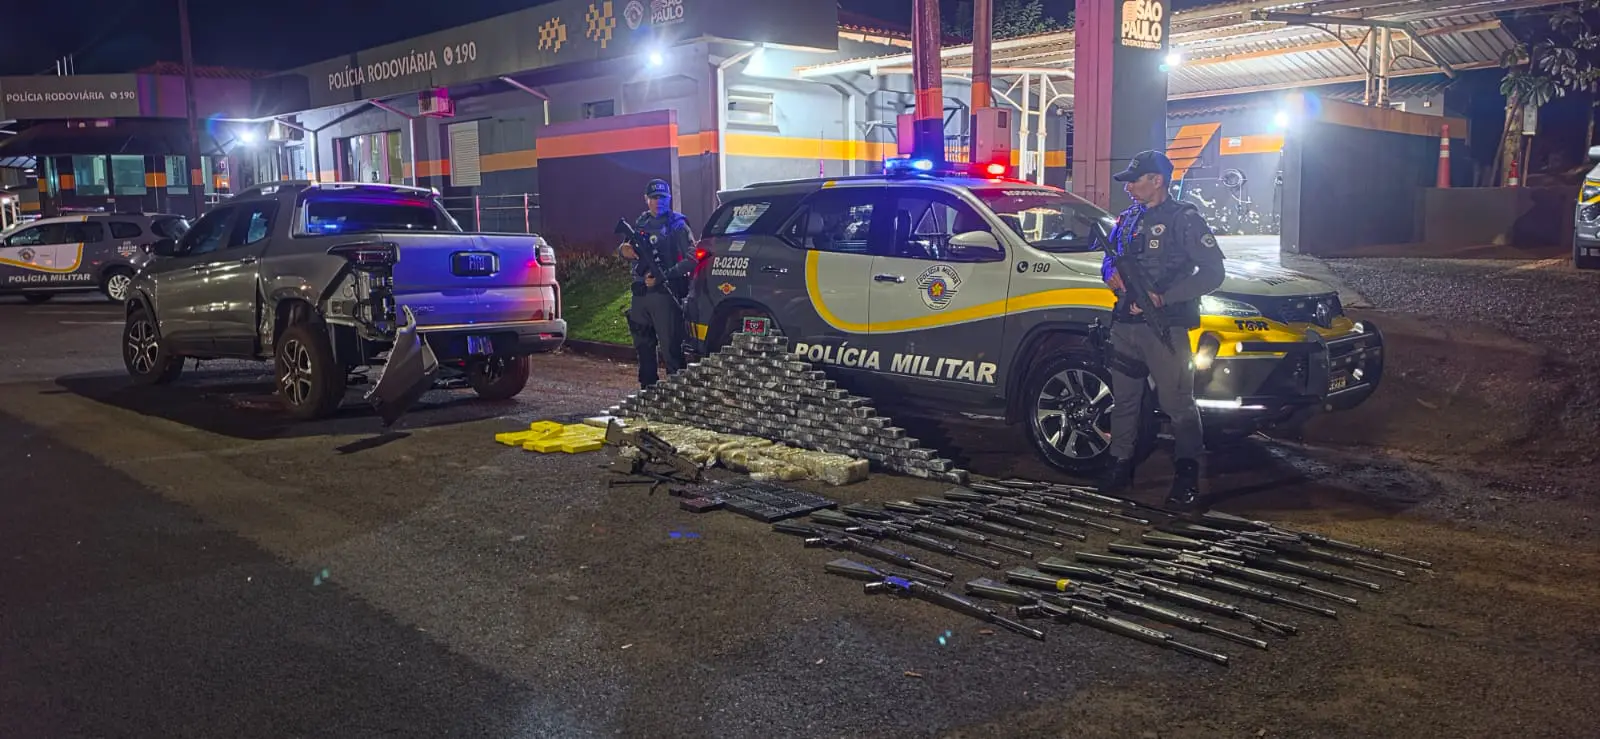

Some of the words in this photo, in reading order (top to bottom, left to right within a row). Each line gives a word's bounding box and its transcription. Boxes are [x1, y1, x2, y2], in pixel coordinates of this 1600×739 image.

[651, 5, 684, 24] PAULO
[1121, 20, 1162, 42] PAULO
[328, 65, 365, 91] POLÍCIA
[367, 49, 438, 83] RODOVIÁRIA
[455, 41, 477, 64] 190
[6, 91, 43, 102] POLÍCIA
[45, 89, 105, 101] RODOVIÁRIA
[119, 91, 135, 100] 190
[712, 256, 750, 270] R-02305
[1032, 262, 1051, 273] 190
[8, 273, 47, 283] POLÍCIA
[50, 273, 91, 282] MILITAR
[794, 341, 880, 370] POLÍCIA
[890, 352, 997, 384] MILITAR
